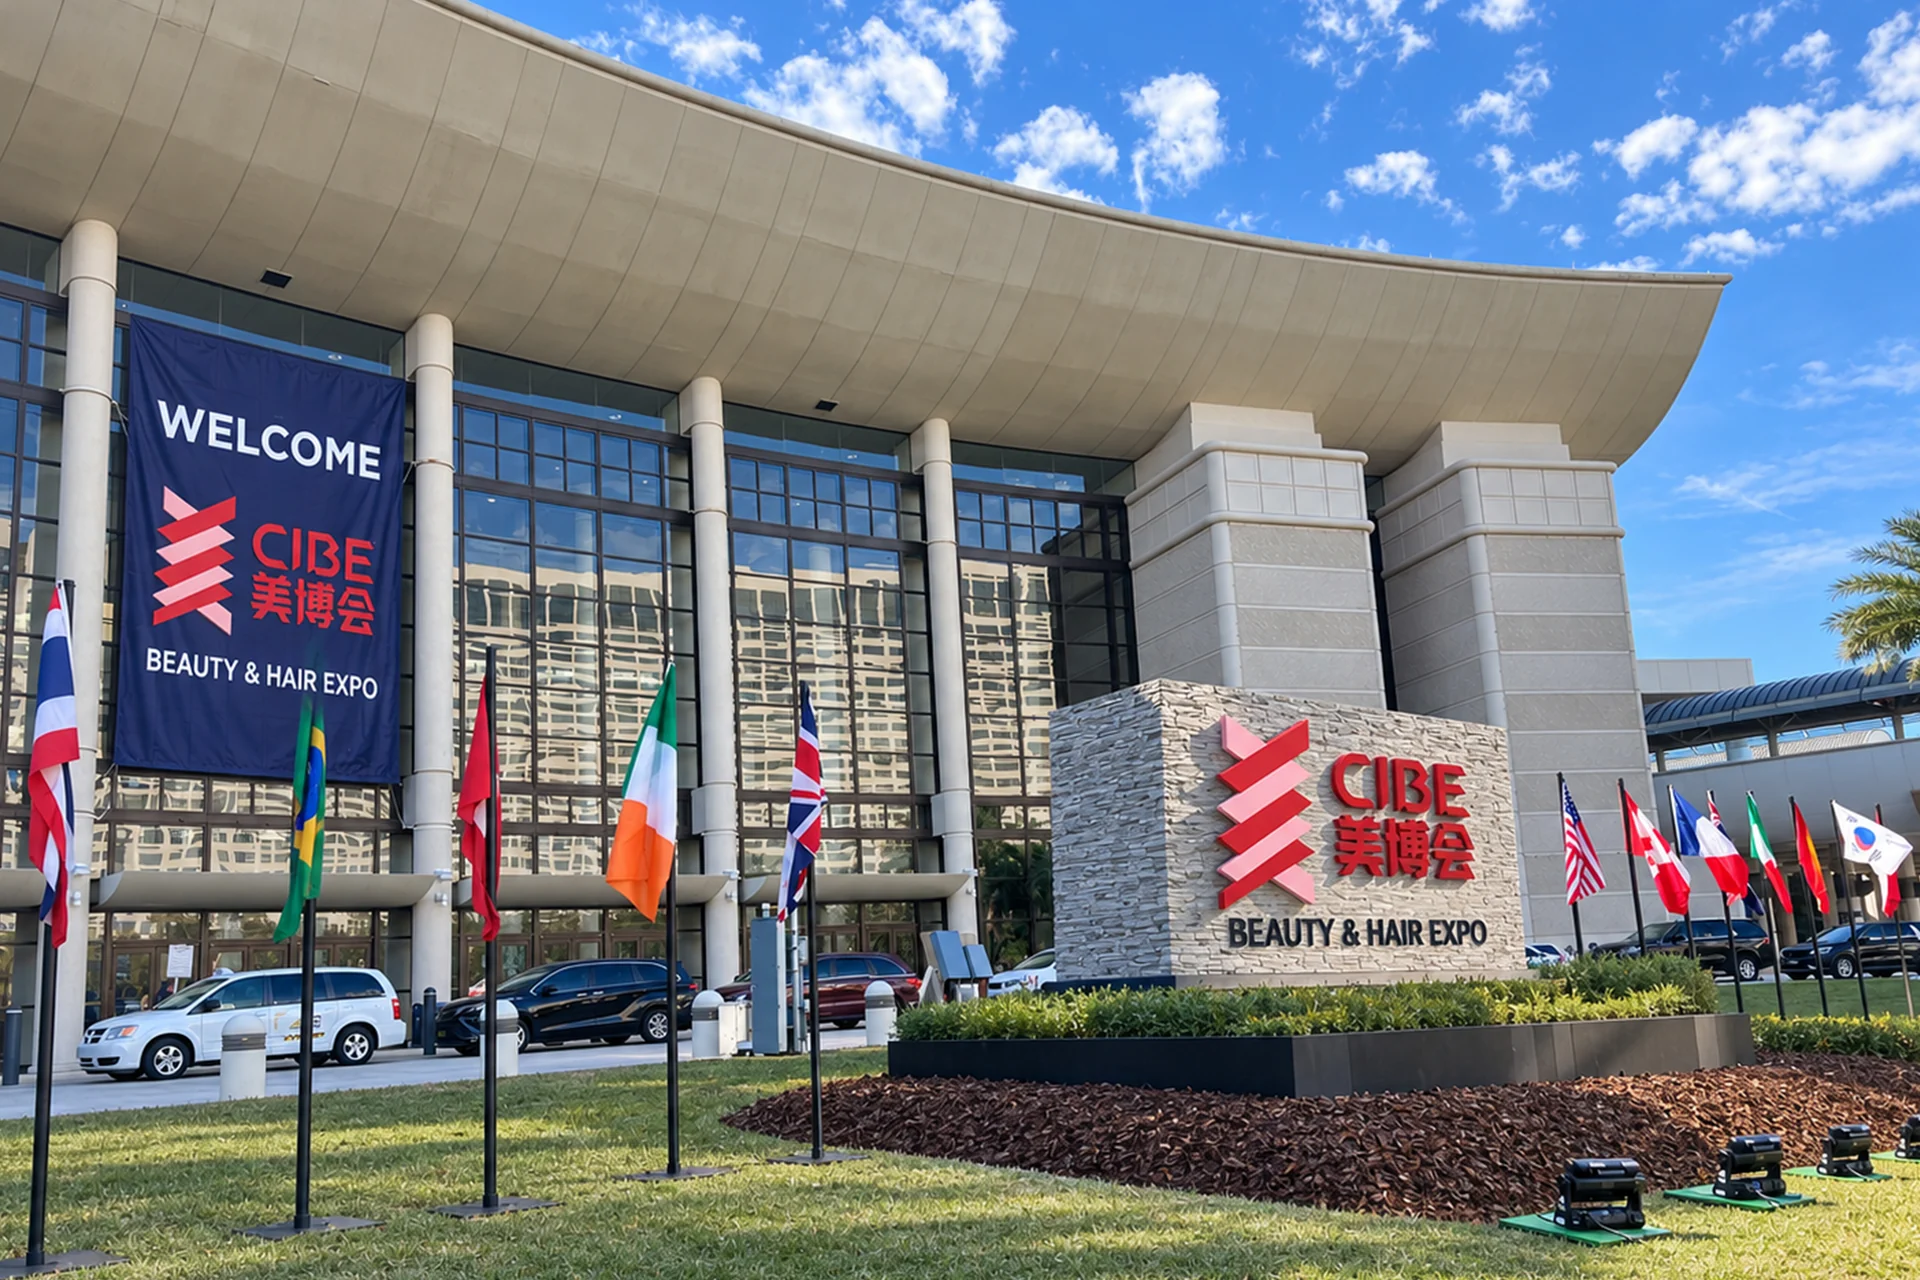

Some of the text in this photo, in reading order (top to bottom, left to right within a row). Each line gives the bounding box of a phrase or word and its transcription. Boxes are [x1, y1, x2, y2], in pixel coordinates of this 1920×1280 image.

[157, 399, 381, 481] WELCOME
[251, 523, 374, 585] CIBE
[250, 571, 375, 636] 美博会
[146, 647, 379, 700] BEAUTY & HAIR EXPO
[1331, 752, 1471, 819] CIBE
[1333, 814, 1476, 881] 美博会
[1228, 917, 1488, 949] BEAUTY & HAIR EXPO
